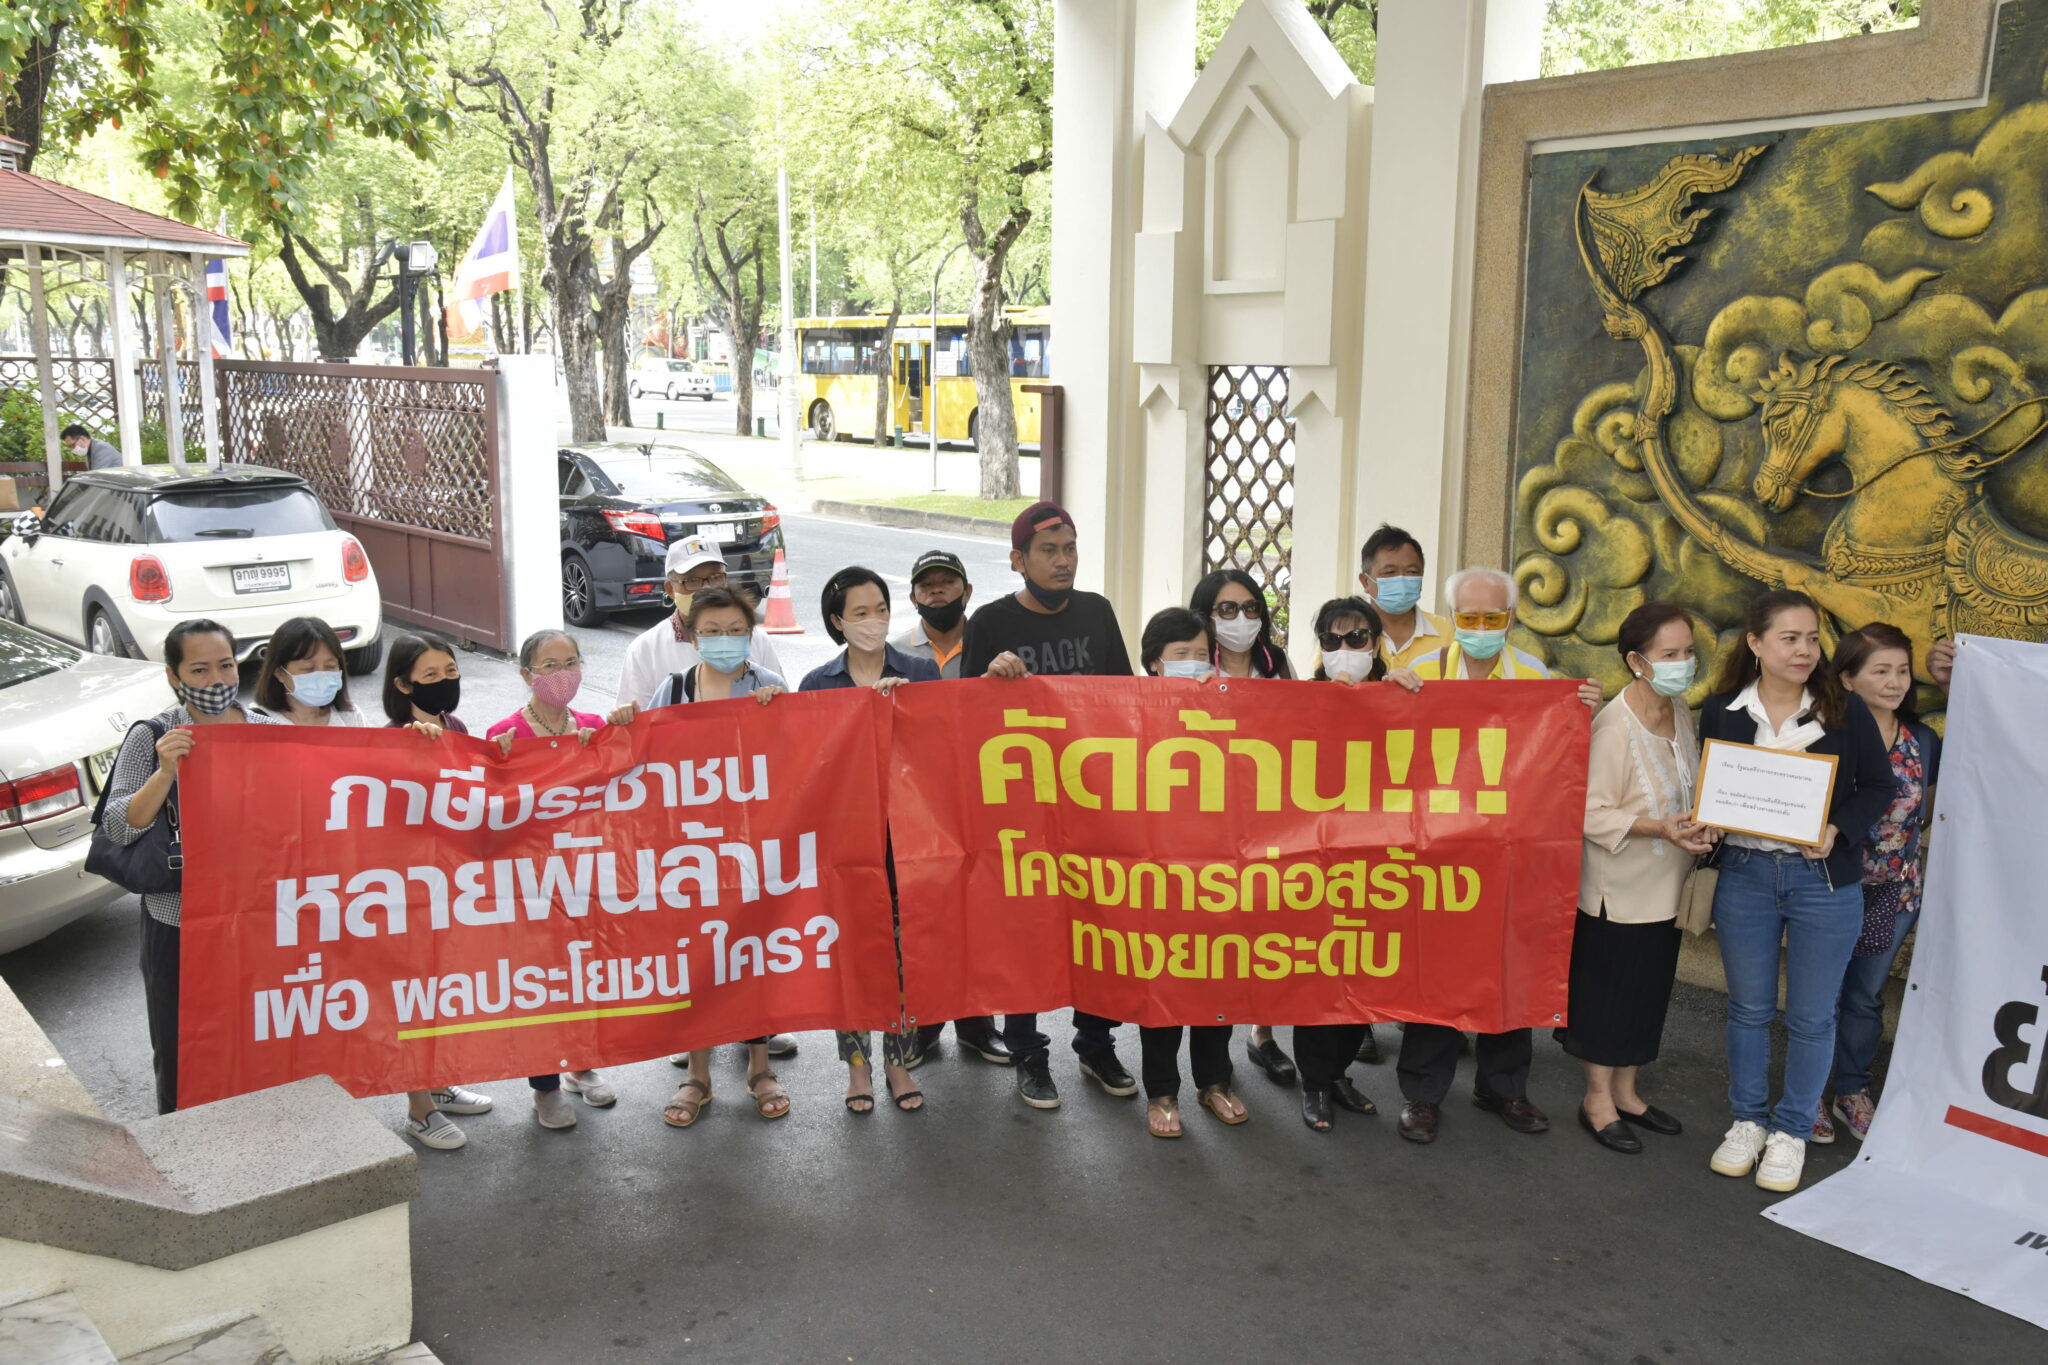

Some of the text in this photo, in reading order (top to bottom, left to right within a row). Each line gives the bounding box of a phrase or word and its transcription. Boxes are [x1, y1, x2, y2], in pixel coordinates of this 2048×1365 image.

[260, 567, 286, 578] 9995
[1017, 636, 1094, 675] BACK
[326, 754, 770, 832] ภาษีประชาชน
[978, 708, 1508, 815] คัดค้าน!!!
[275, 821, 818, 948] หลายพันล้าน
[997, 828, 1482, 913] โครงการก่อสร้าง
[254, 914, 841, 1042] เพื่อ ผลประโยชน์ ใคร?
[1071, 913, 1402, 981] ทางยกระดับ
